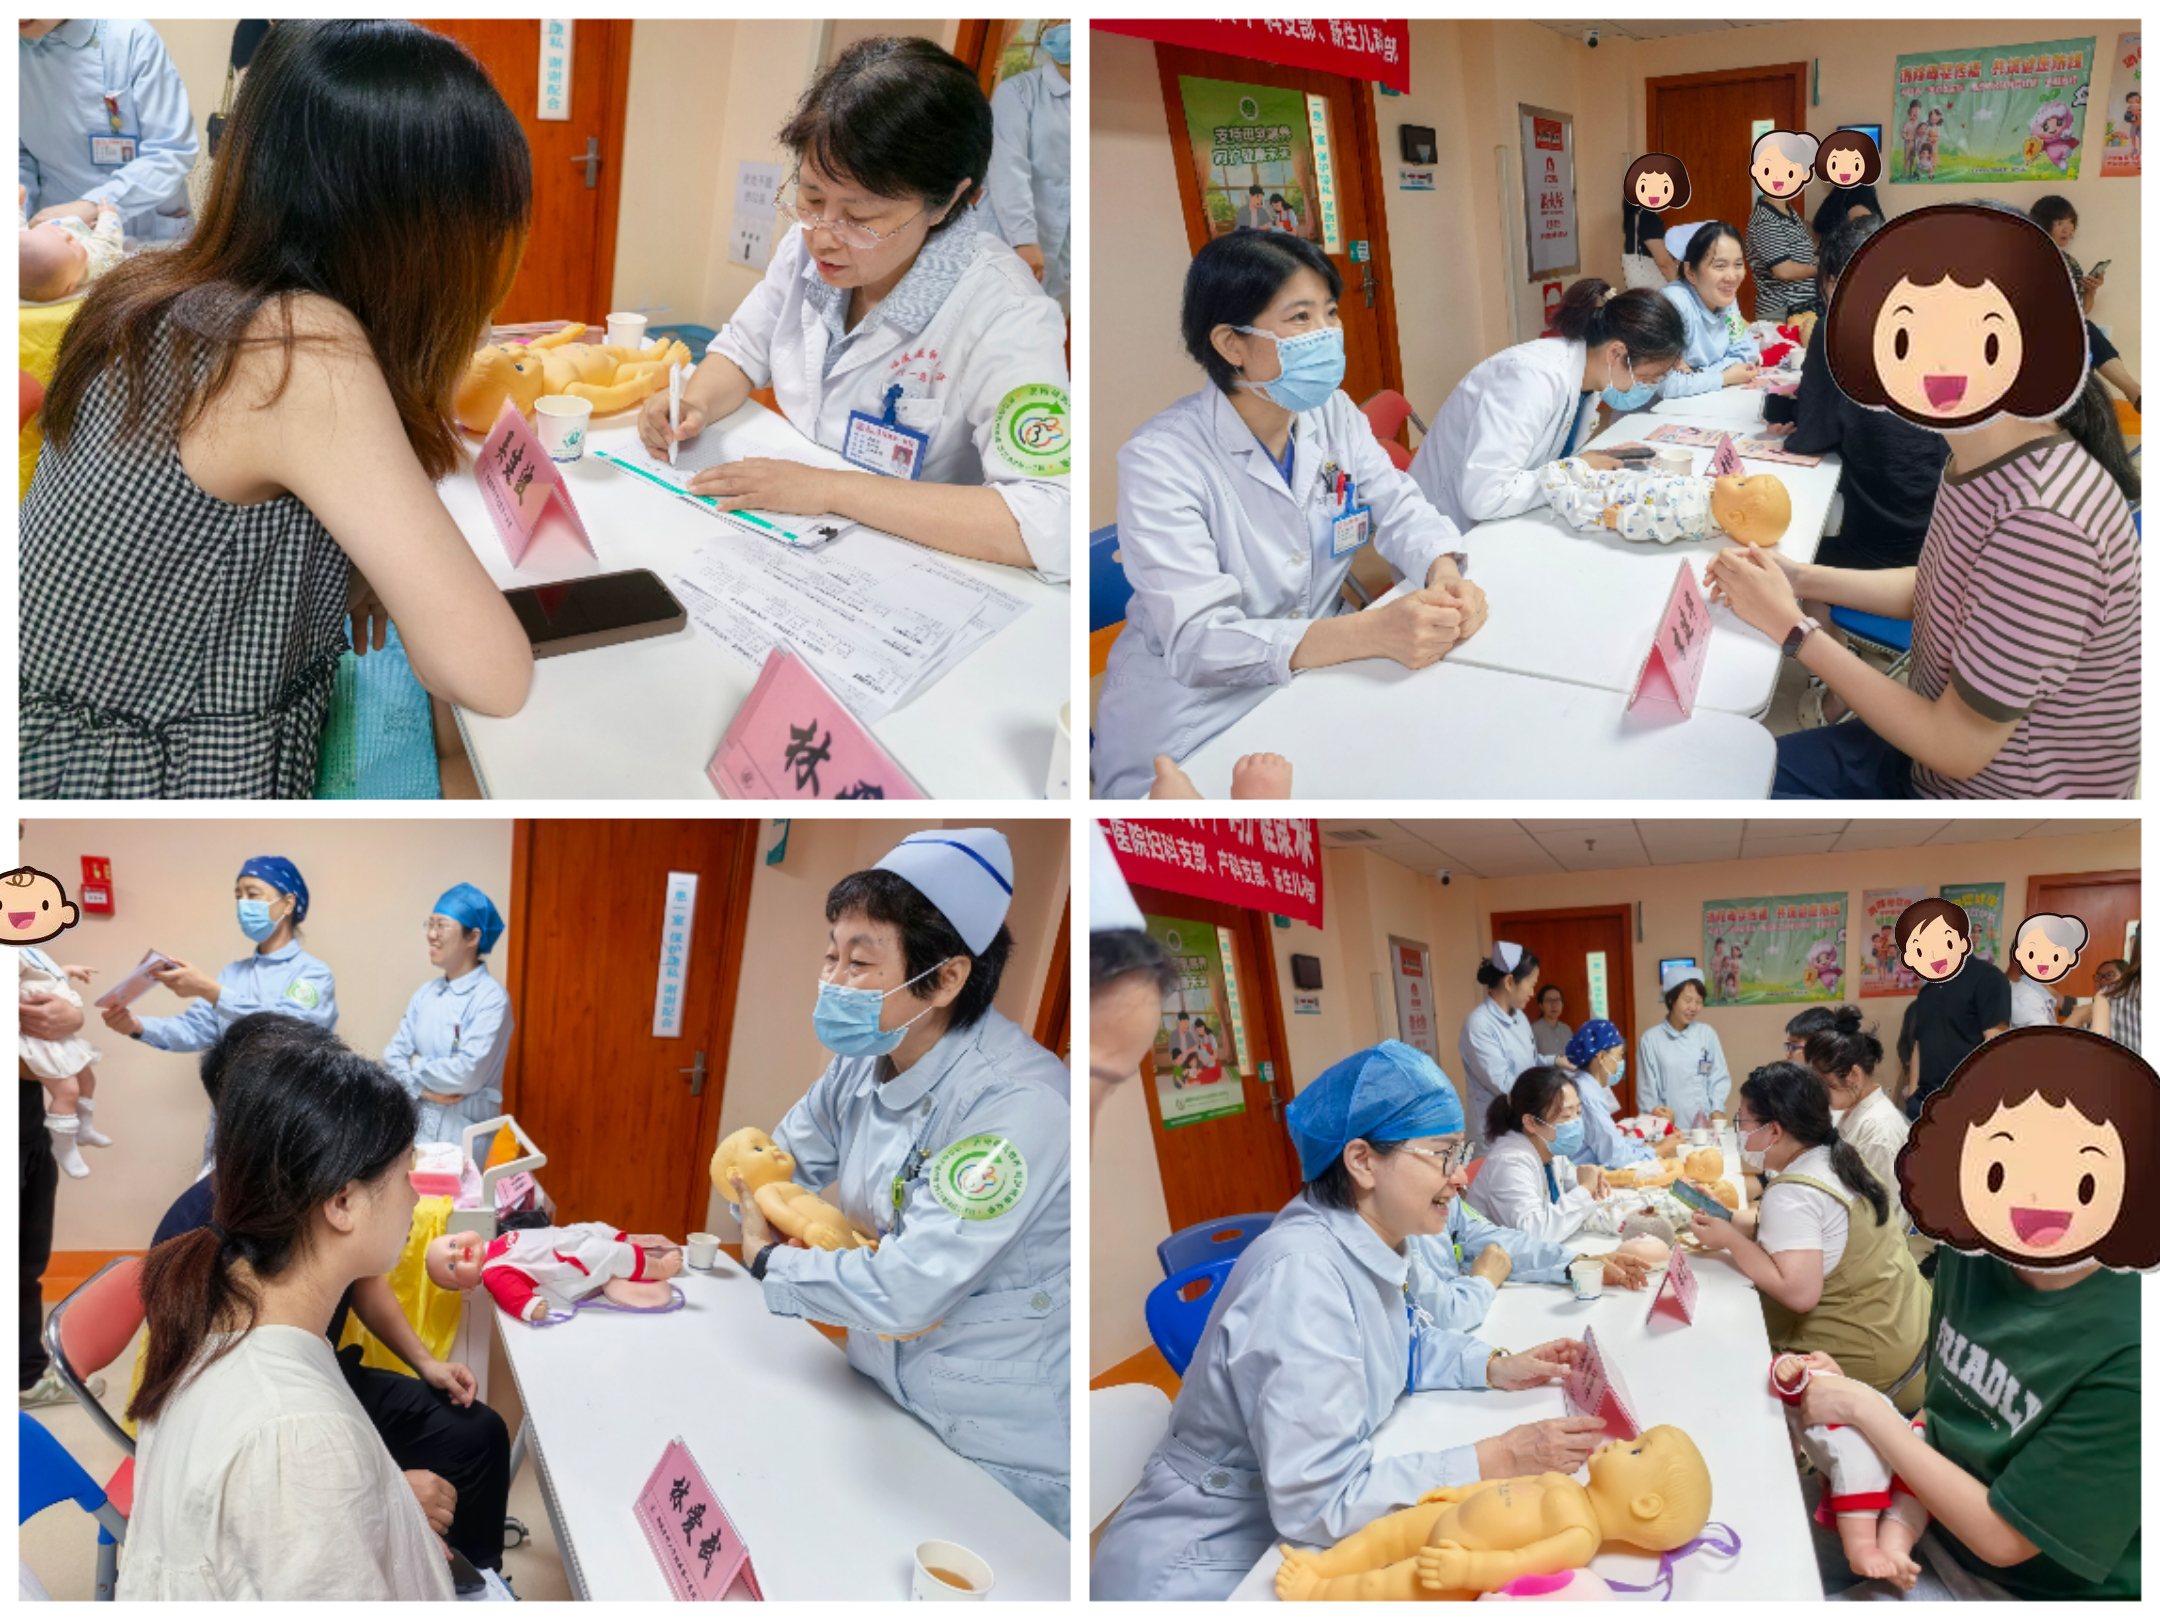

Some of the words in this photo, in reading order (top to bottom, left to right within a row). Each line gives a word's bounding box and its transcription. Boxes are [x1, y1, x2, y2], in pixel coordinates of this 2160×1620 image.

[549, 19, 564, 49] 隐私
[547, 56, 563, 110] 谢谢配合
[1899, 62, 1982, 83] 消除母婴传播
[1214, 125, 1292, 145] 支持母乳喂养
[1311, 103, 1327, 145] 一患一室
[1316, 151, 1333, 195] 保护隐私
[671, 882, 689, 927] 一患一室
[666, 931, 683, 979] 保护隐私
[661, 983, 678, 1029] 谢谢配合
